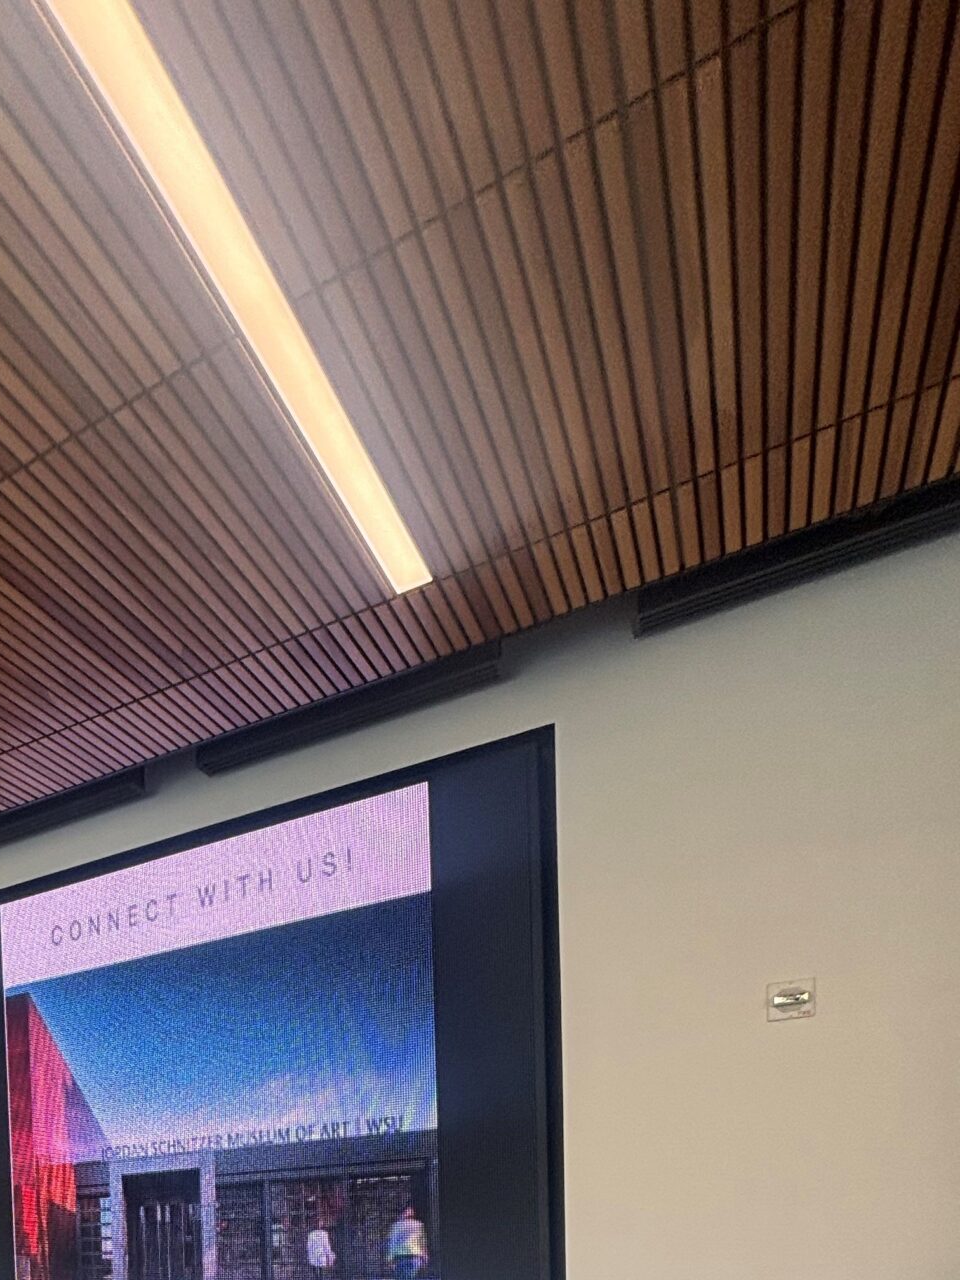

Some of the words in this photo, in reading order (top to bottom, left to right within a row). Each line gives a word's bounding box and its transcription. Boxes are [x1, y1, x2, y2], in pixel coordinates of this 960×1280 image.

[51, 894, 177, 945] CONNECT
[196, 869, 274, 908] WITH
[296, 848, 354, 884] US!
[320, 1120, 349, 1139] ART
